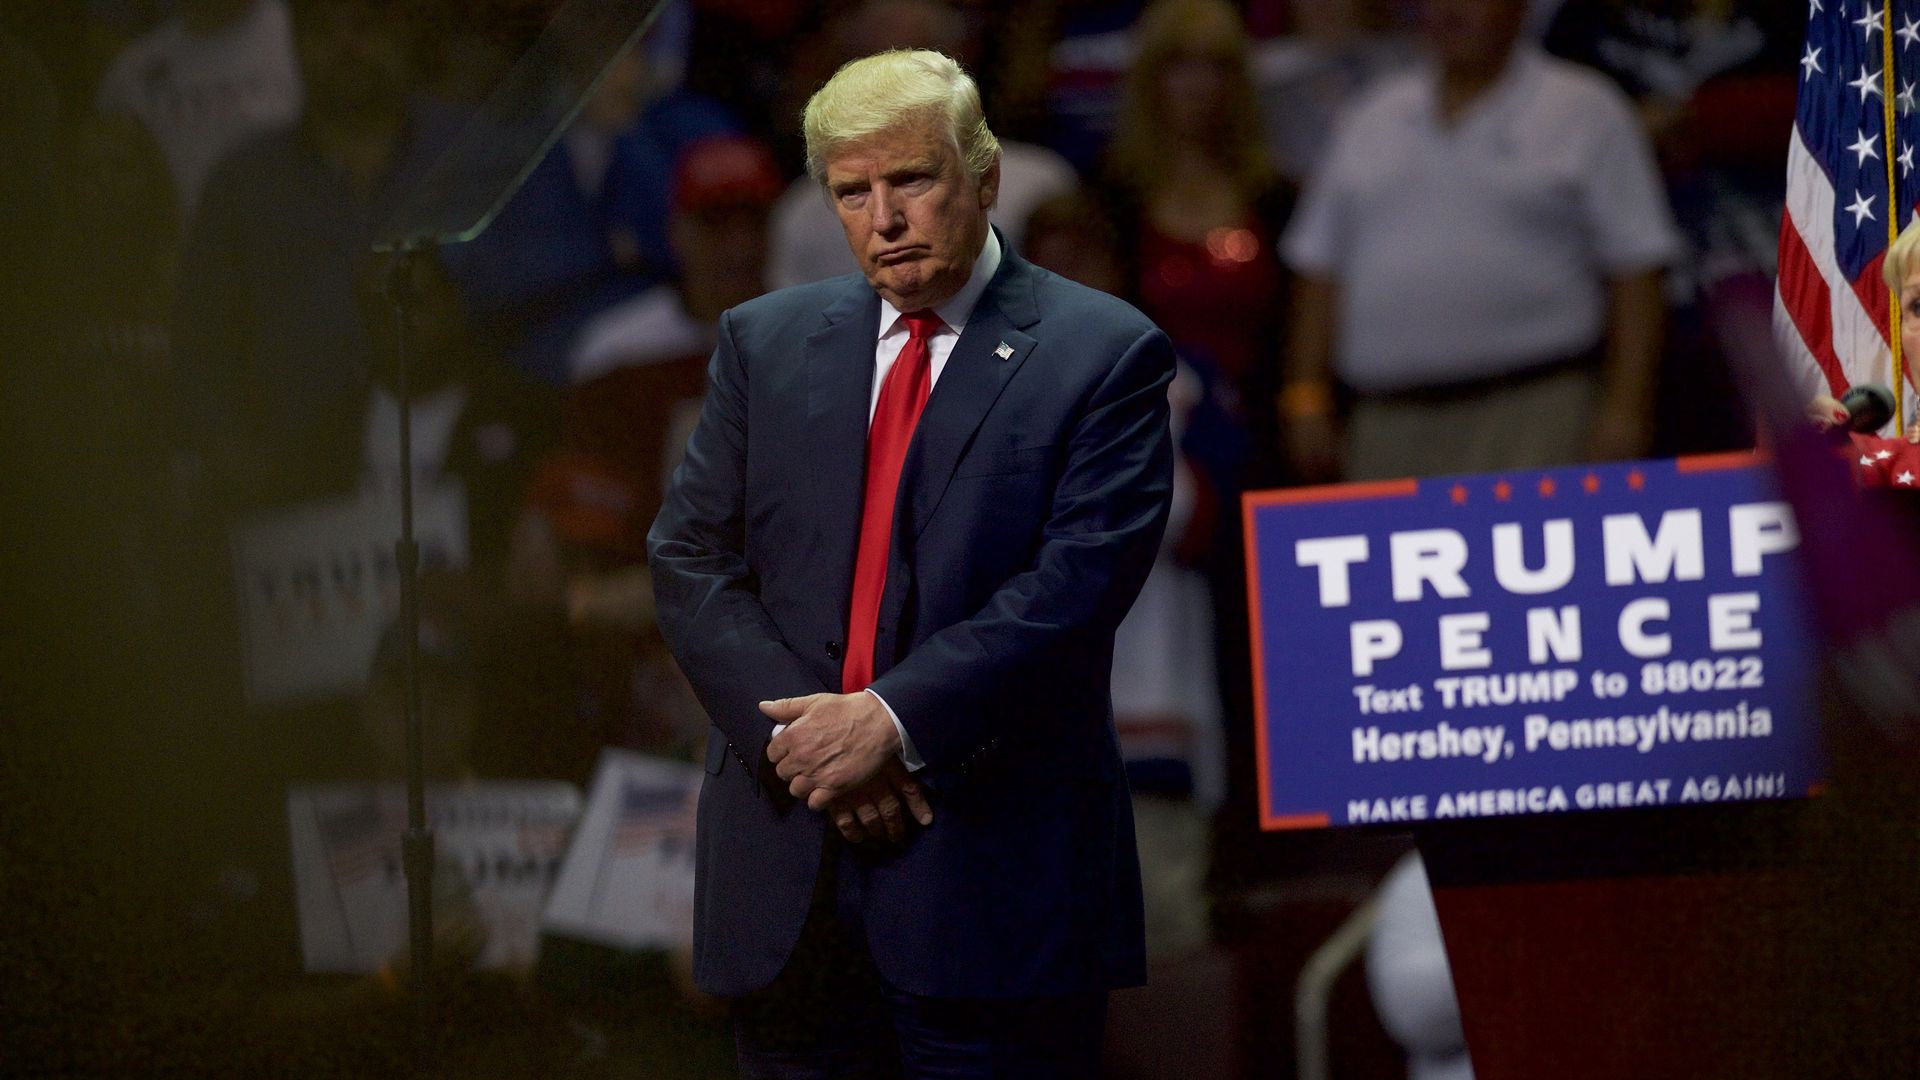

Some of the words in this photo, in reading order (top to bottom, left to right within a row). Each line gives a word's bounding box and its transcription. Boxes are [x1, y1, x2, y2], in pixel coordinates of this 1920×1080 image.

[1296, 502, 1798, 606] TRUMP
[1351, 593, 1762, 676] PENCE
[1354, 685, 1423, 714] Text
[1434, 670, 1578, 708] TRUMP
[1591, 670, 1628, 698] to
[1640, 657, 1763, 694] 88022
[1352, 722, 1514, 763] Hershey,
[1524, 703, 1772, 752] Pennsylvania
[1348, 795, 1428, 823] MAKE
[1434, 786, 1569, 818] AMERICA
[1574, 779, 1672, 809] GREAT
[1680, 773, 1785, 804] AGAIN!
